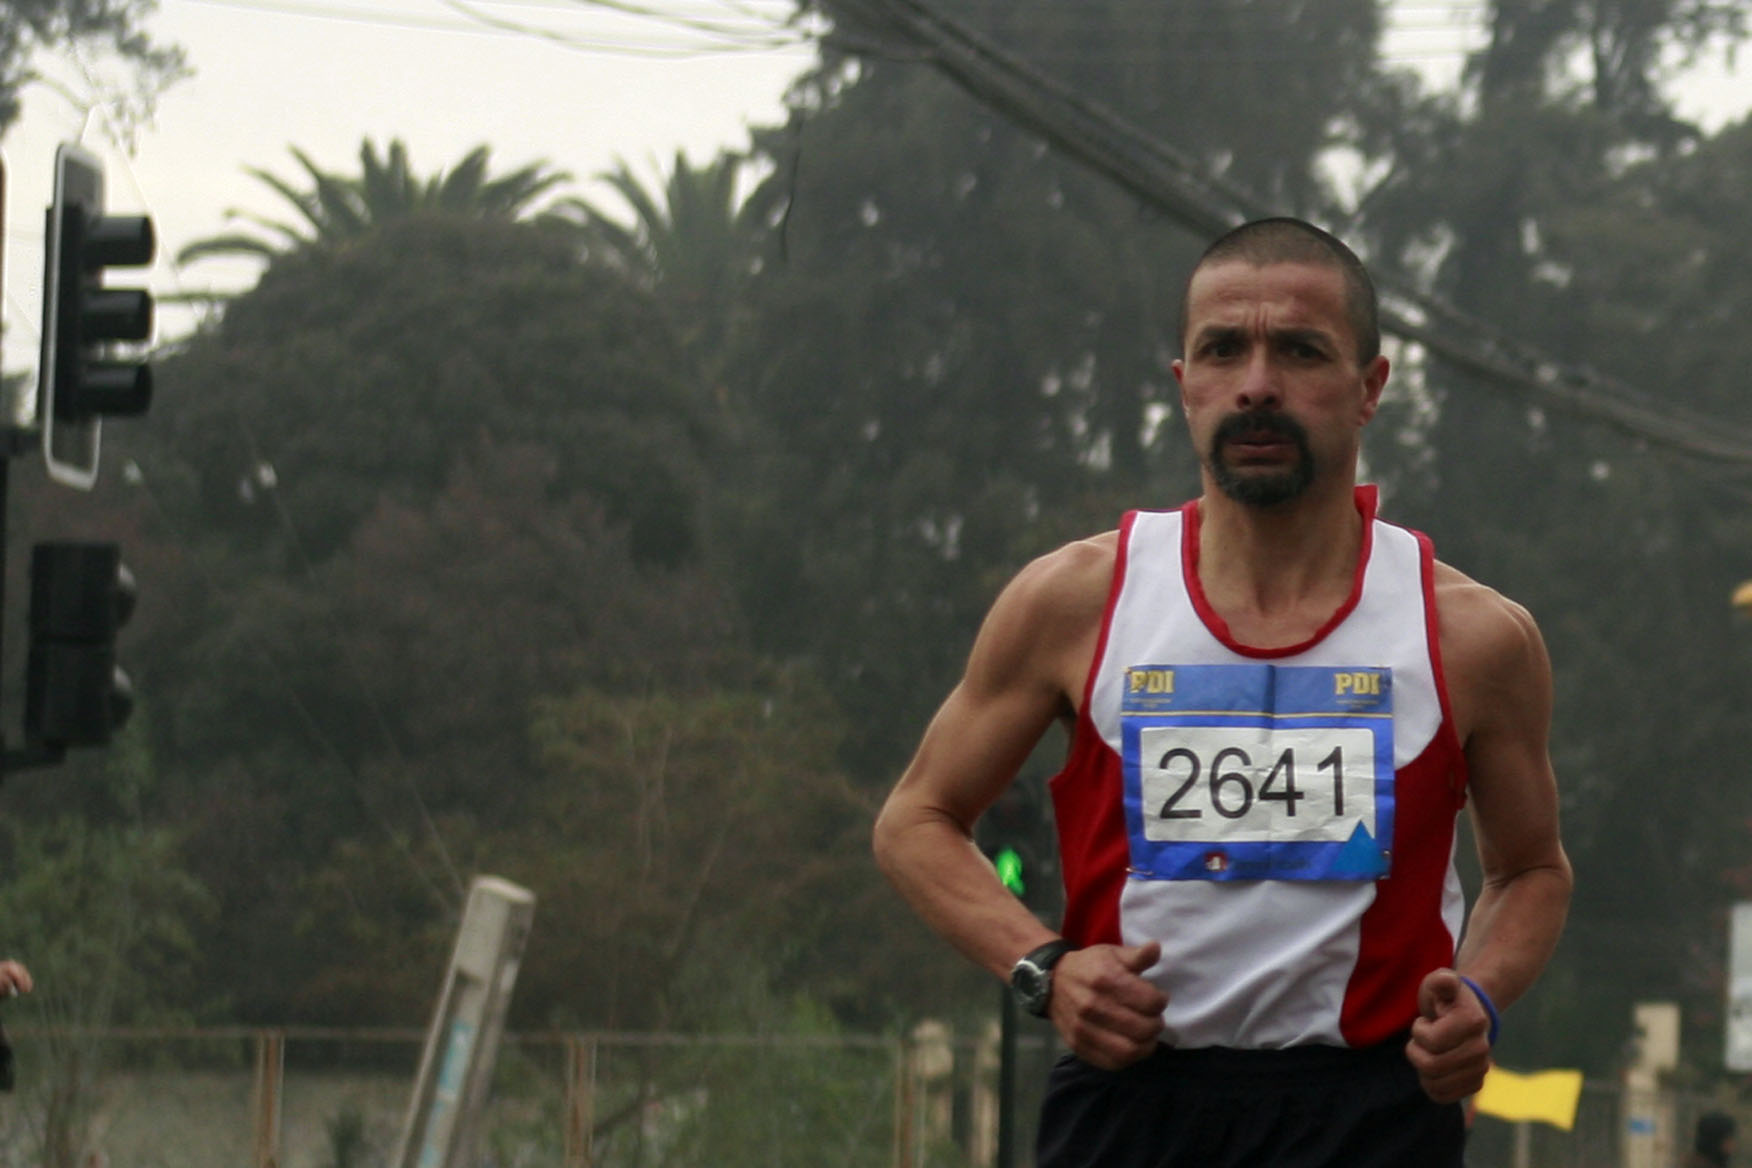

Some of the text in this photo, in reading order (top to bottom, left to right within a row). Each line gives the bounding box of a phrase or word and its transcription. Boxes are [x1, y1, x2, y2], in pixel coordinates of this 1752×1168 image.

[1130, 670, 1175, 694] PDI
[1335, 672, 1380, 696] PDI
[1158, 746, 1344, 819] 2641
